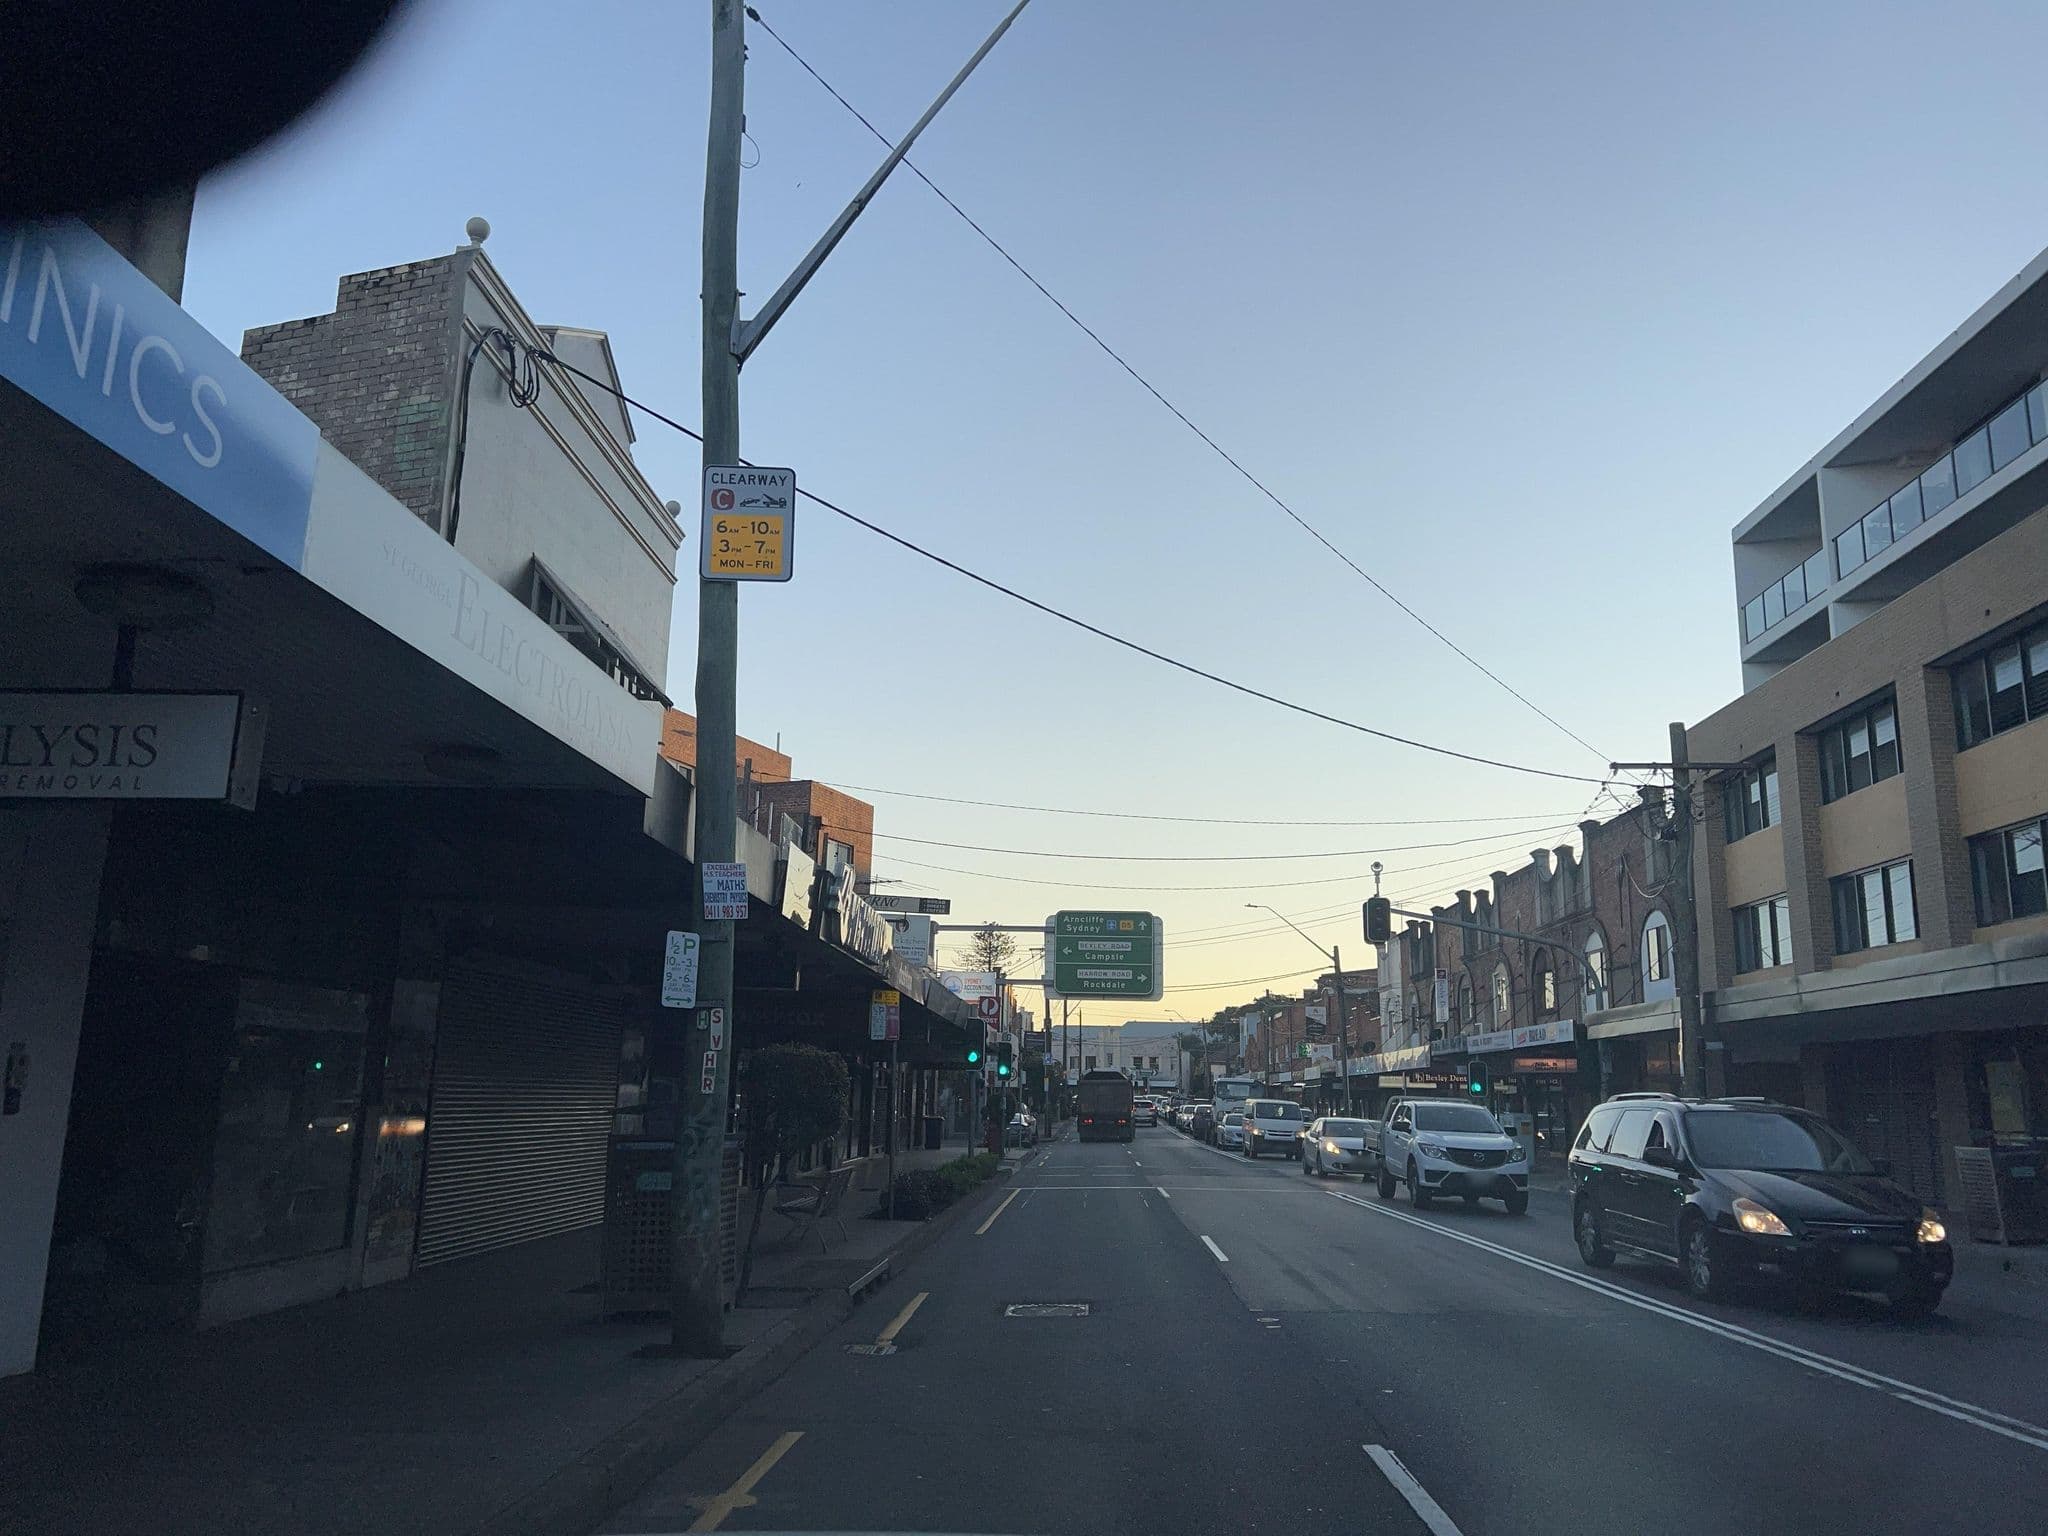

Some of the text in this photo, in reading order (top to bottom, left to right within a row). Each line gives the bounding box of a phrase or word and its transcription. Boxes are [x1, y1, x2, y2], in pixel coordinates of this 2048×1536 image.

[711, 472, 788, 487] CLEARWAY
[716, 490, 730, 509] C
[717, 879, 745, 891] MATHS
[1063, 915, 1105, 923] Arncliffe
[1066, 924, 1101, 933] Sydney
[1085, 952, 1125, 961] Campsie
[1083, 980, 1126, 989] Rockdale
[1425, 1074, 1448, 1083] Bexley
